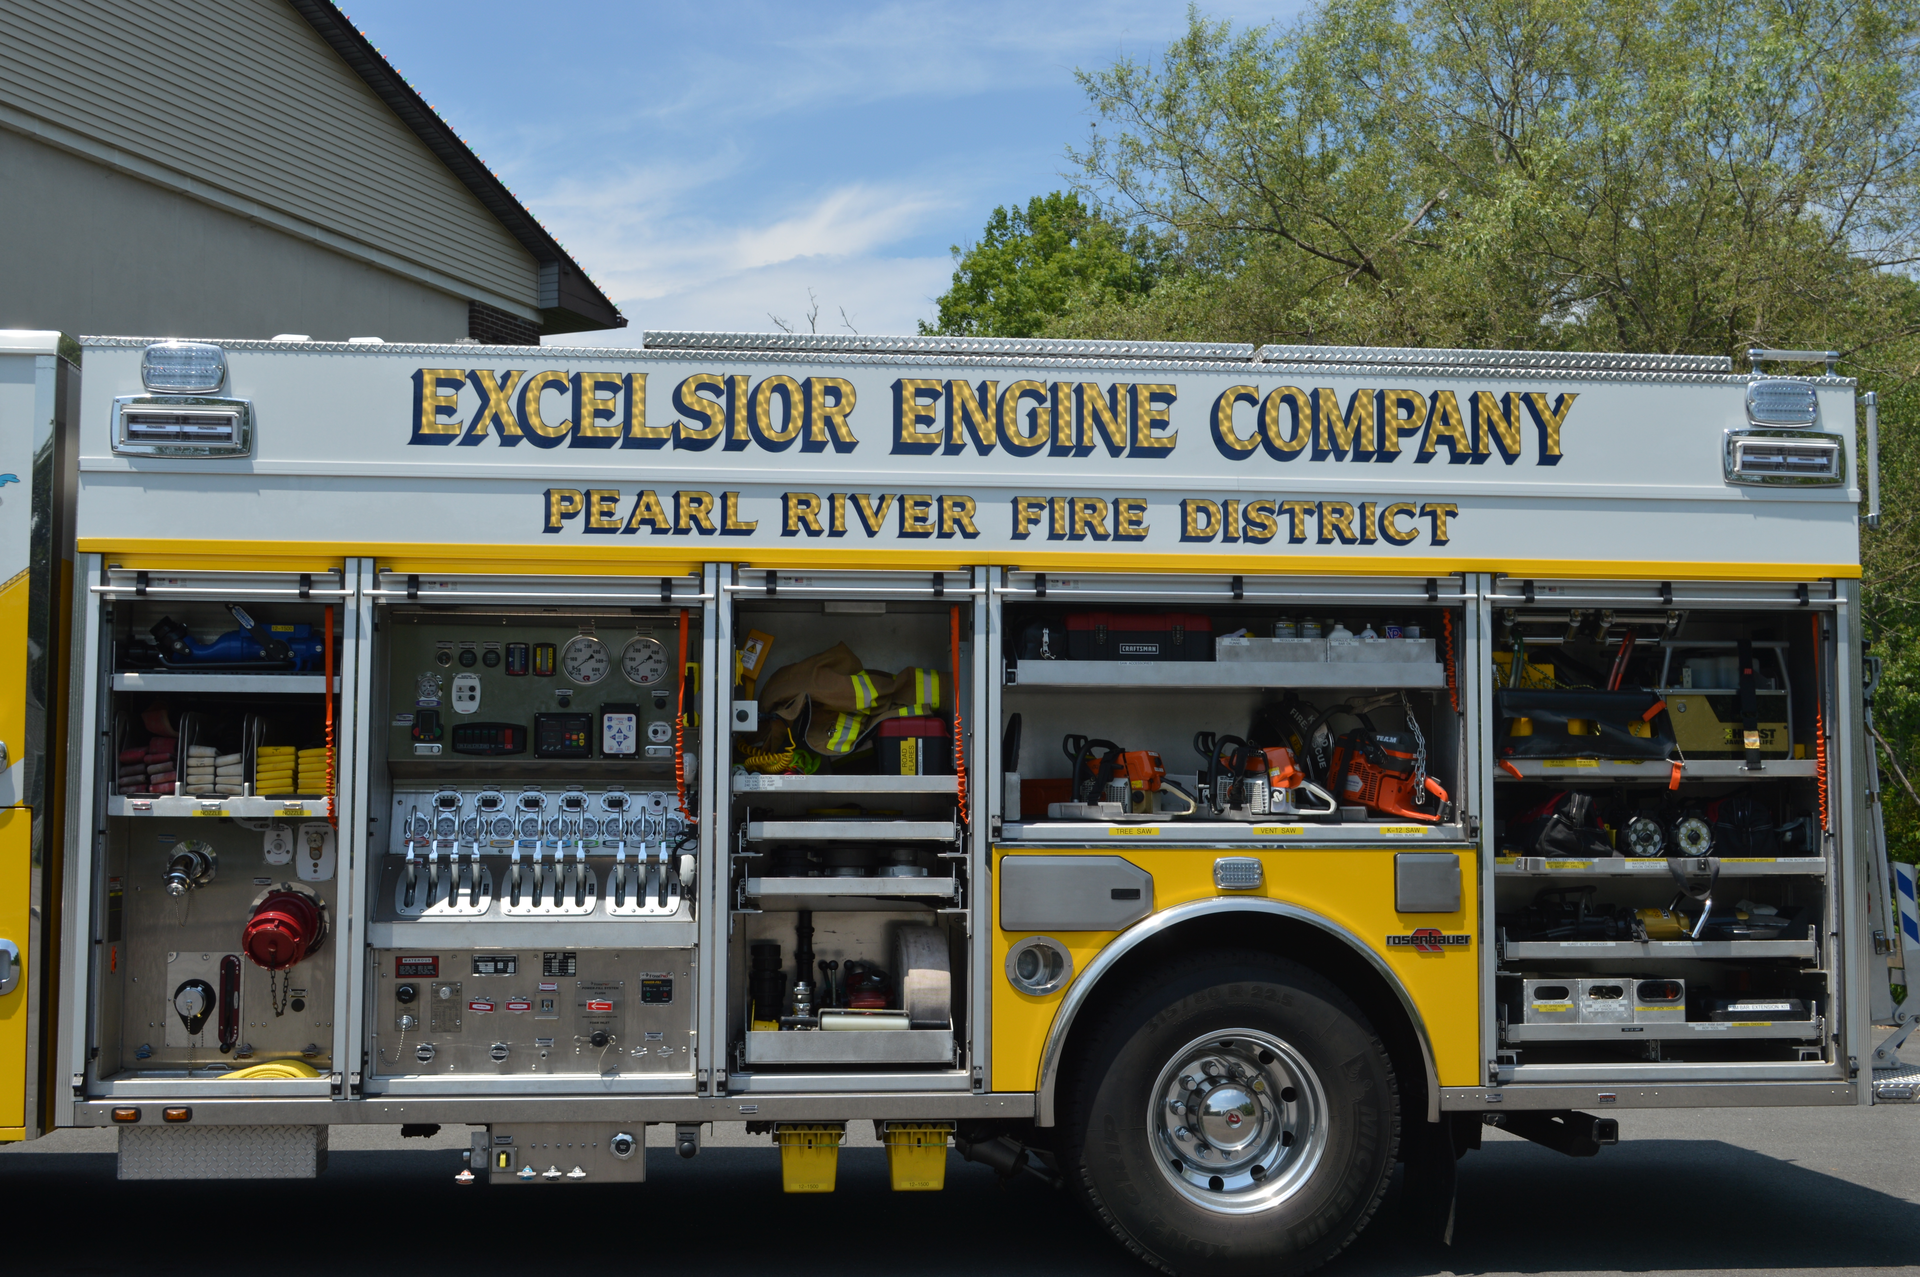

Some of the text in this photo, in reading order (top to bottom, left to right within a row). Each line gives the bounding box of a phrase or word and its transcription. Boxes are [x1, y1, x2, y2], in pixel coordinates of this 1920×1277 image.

[407, 367, 1580, 467] EXCELSIOR ENGINE COMPANY
[541, 487, 1459, 547] PEARL RIVER FIRE DISTRICT
[1376, 735, 1397, 743] TEAM
[1733, 729, 1776, 738] HST
[1387, 931, 1471, 945] rosenbauer
[1228, 984, 1244, 998] R
[1251, 985, 1295, 1007] 22.5
[1103, 1113, 1142, 1206] GRIP
[1296, 1106, 1378, 1250] MICHELIN
